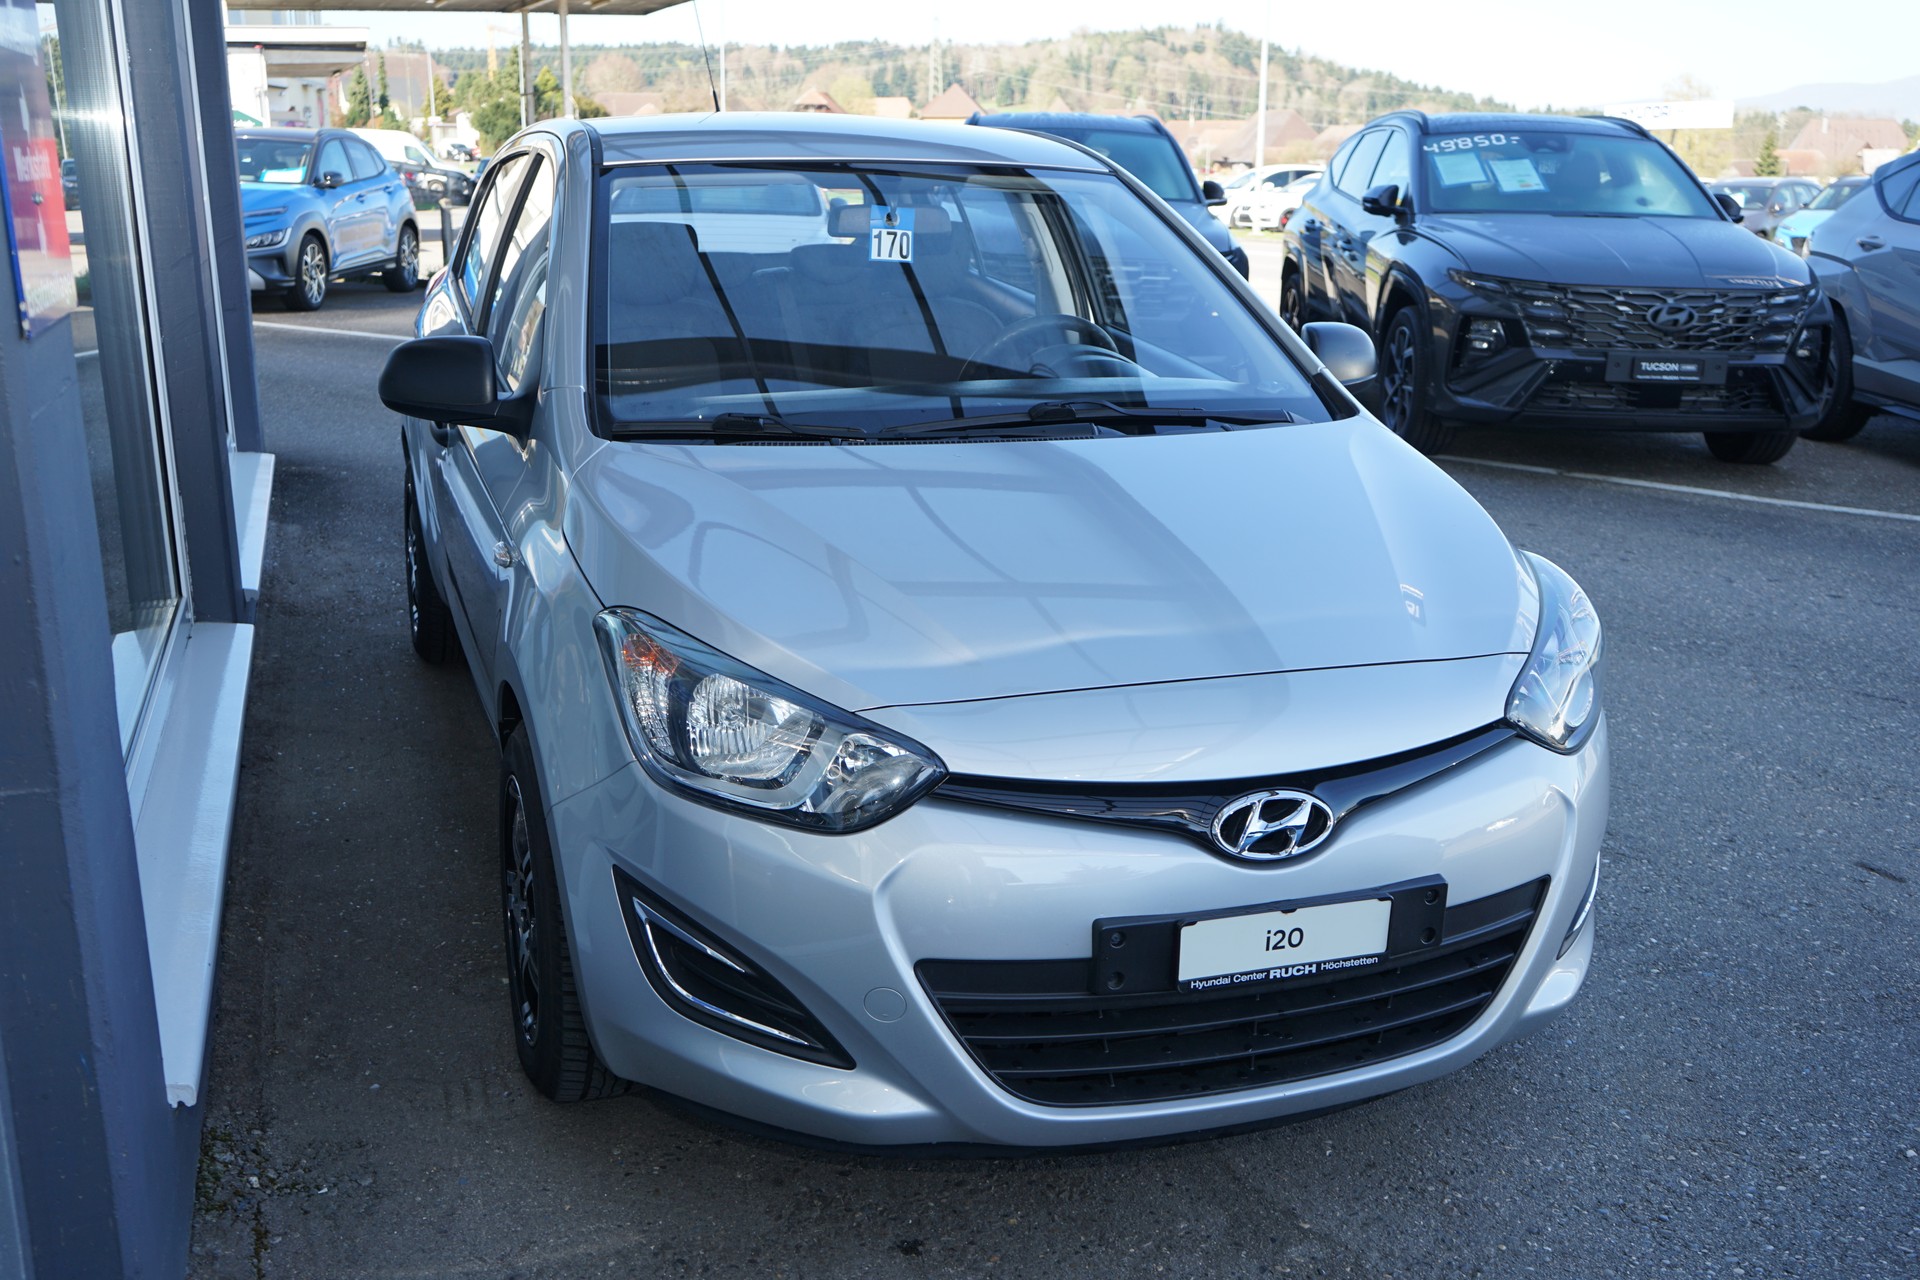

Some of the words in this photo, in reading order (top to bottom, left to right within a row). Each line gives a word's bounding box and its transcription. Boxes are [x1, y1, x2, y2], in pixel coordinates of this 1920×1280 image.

[873, 230, 910, 260] 170
[1640, 361, 1679, 372] TUCSON
[1265, 927, 1304, 952] i20
[1190, 973, 1232, 990] Hyundai
[1233, 969, 1268, 983] Center
[1269, 963, 1317, 980] RUCH
[1320, 955, 1379, 971] Höchstetten
